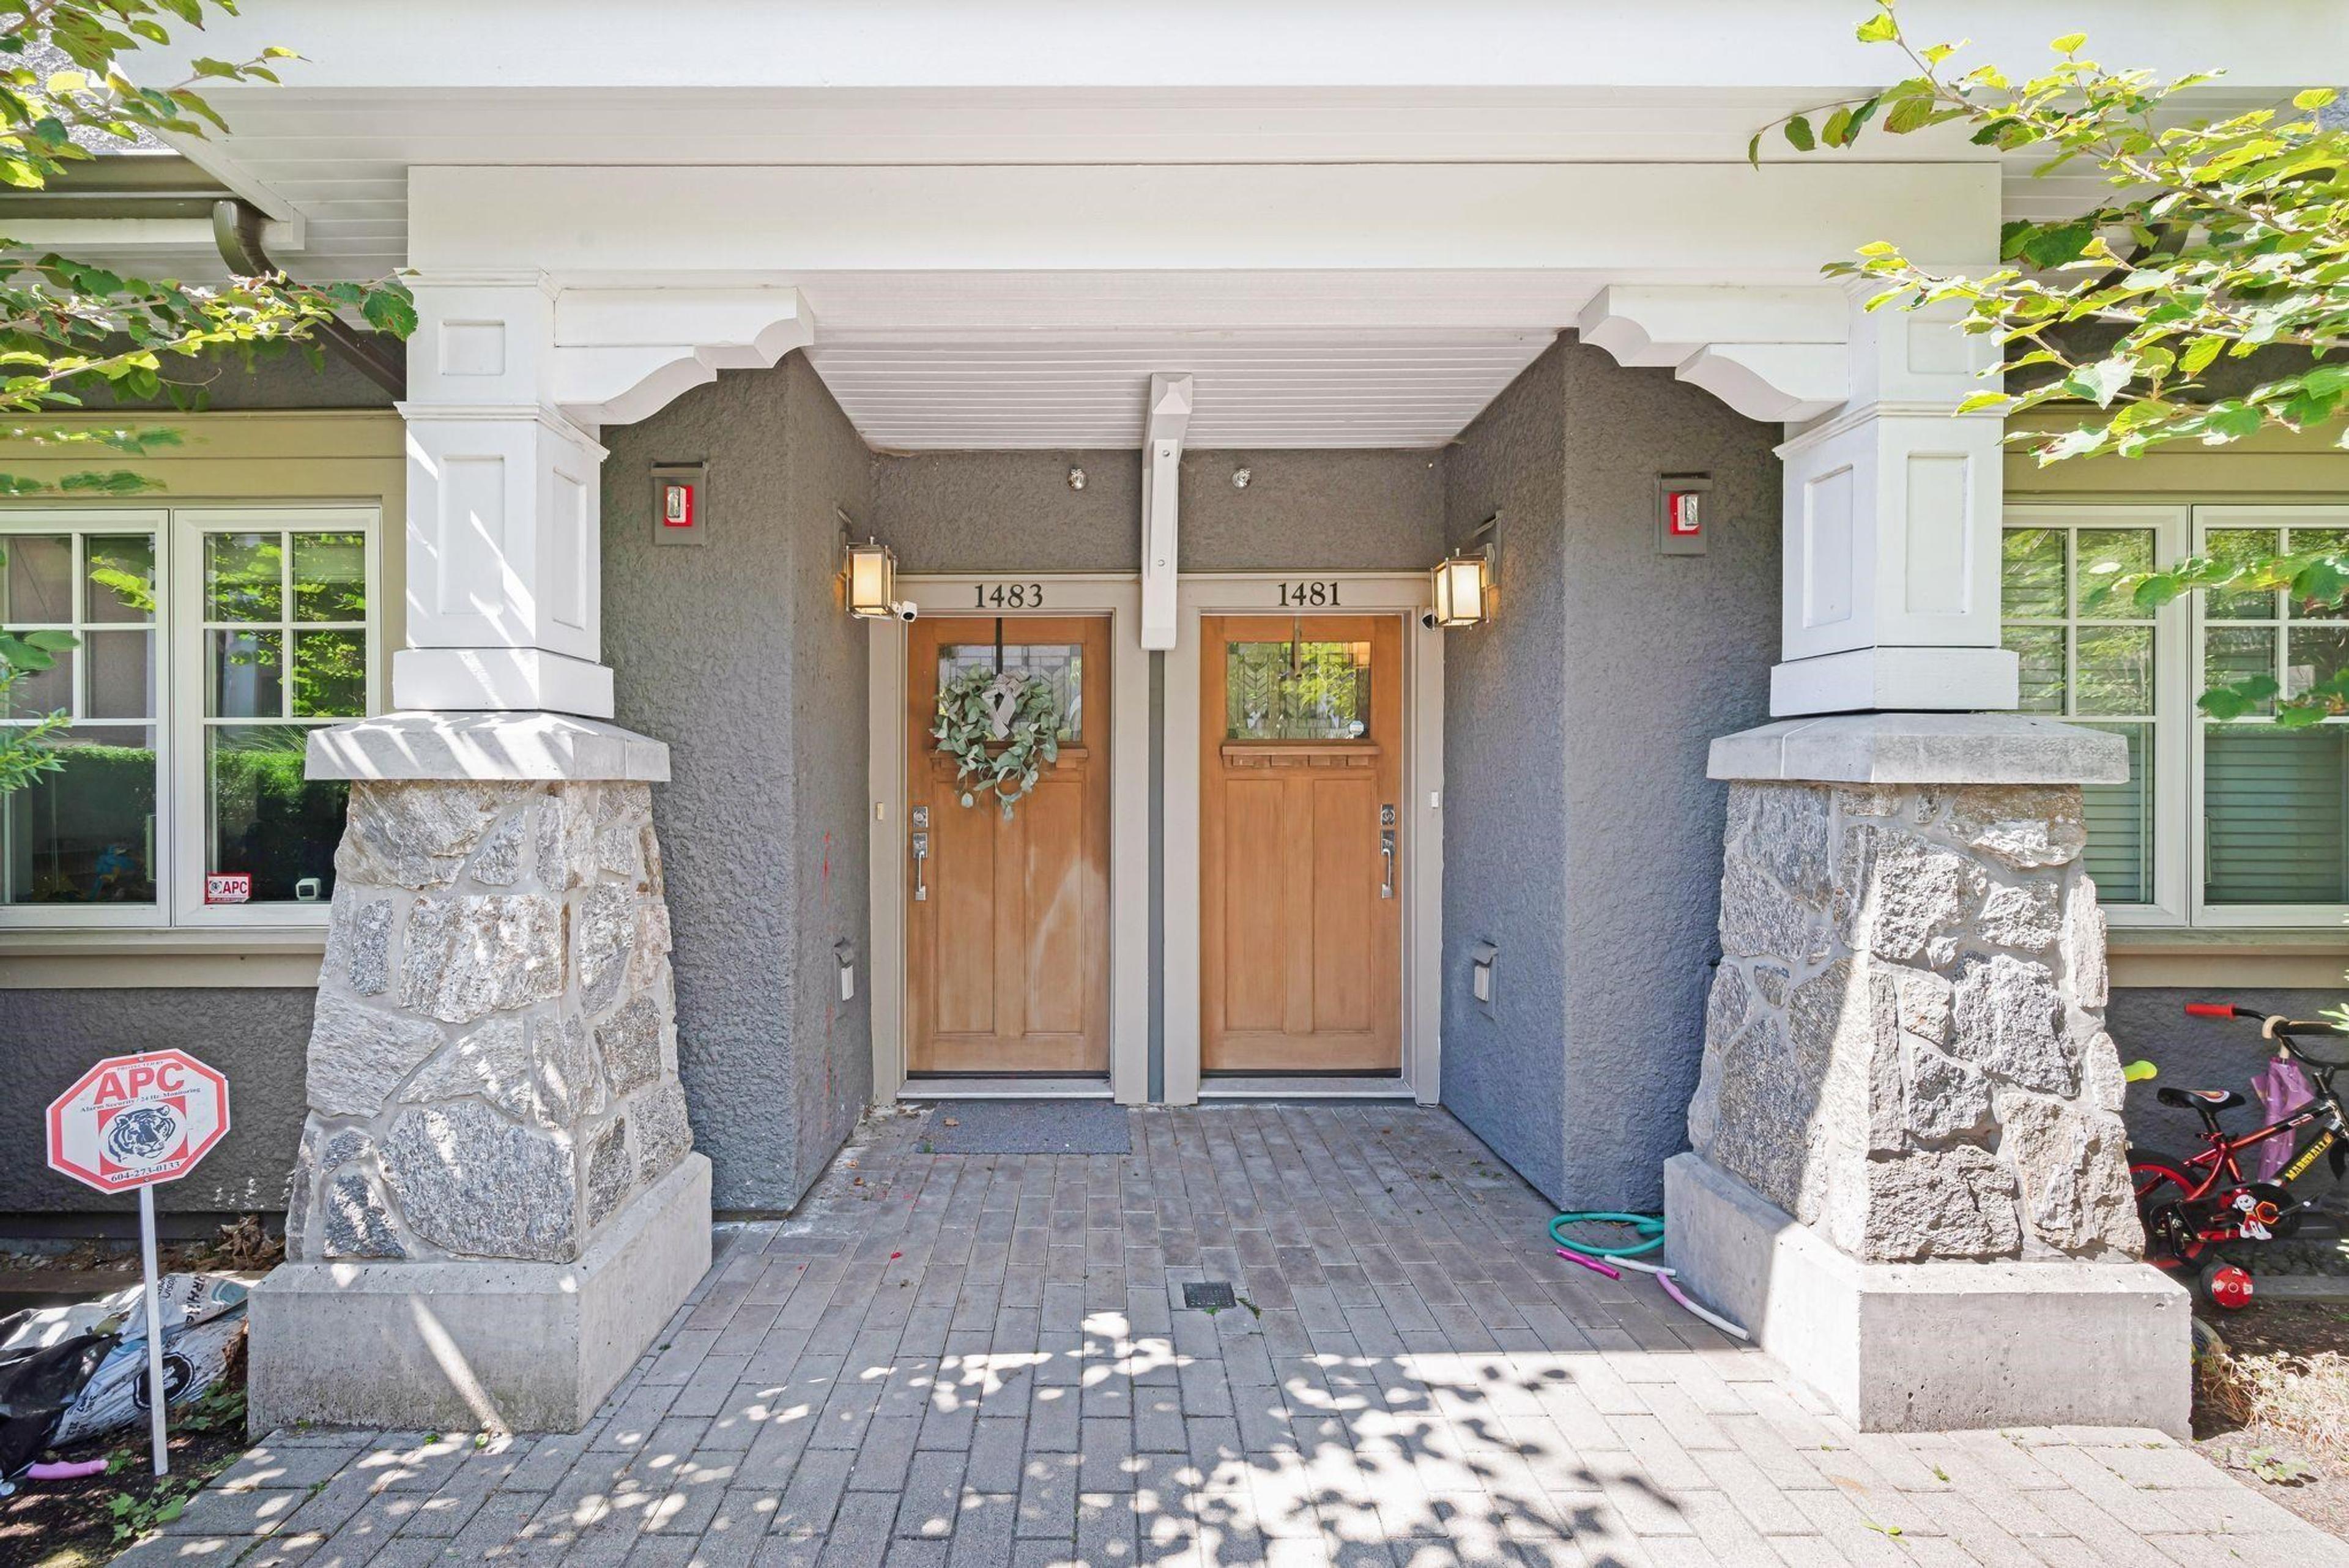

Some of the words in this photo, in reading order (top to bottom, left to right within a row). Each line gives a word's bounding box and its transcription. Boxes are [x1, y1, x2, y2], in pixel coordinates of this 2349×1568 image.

[974, 583, 1043, 608] 1483
[1278, 582, 1341, 606] 1481
[223, 881, 247, 893] APC
[94, 1063, 185, 1105] APC
[111, 1161, 180, 1181] 604-273-0133
